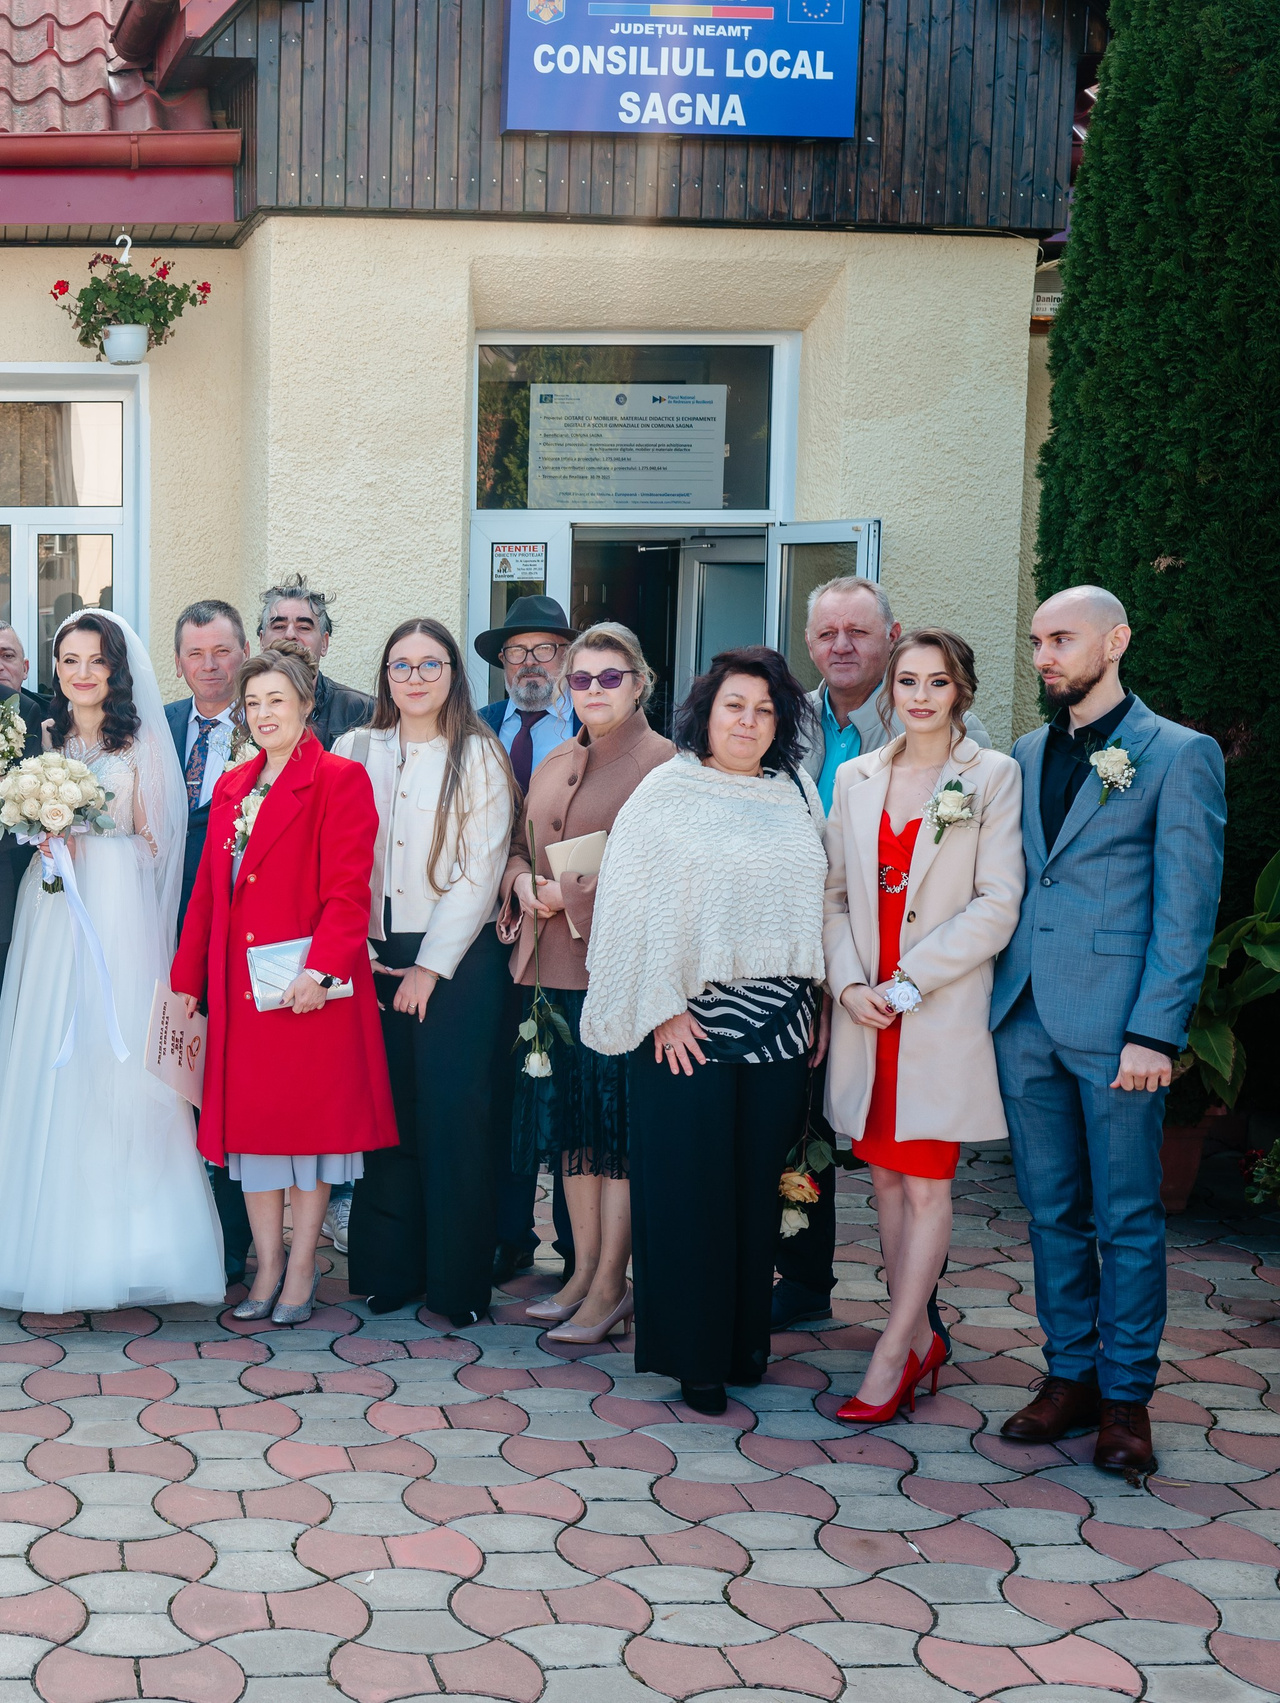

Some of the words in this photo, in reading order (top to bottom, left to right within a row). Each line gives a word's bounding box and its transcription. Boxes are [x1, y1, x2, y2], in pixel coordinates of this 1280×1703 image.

[533, 43, 715, 77] CONSILIUL
[725, 48, 834, 80] LOCAL
[618, 91, 747, 127] SAGNA
